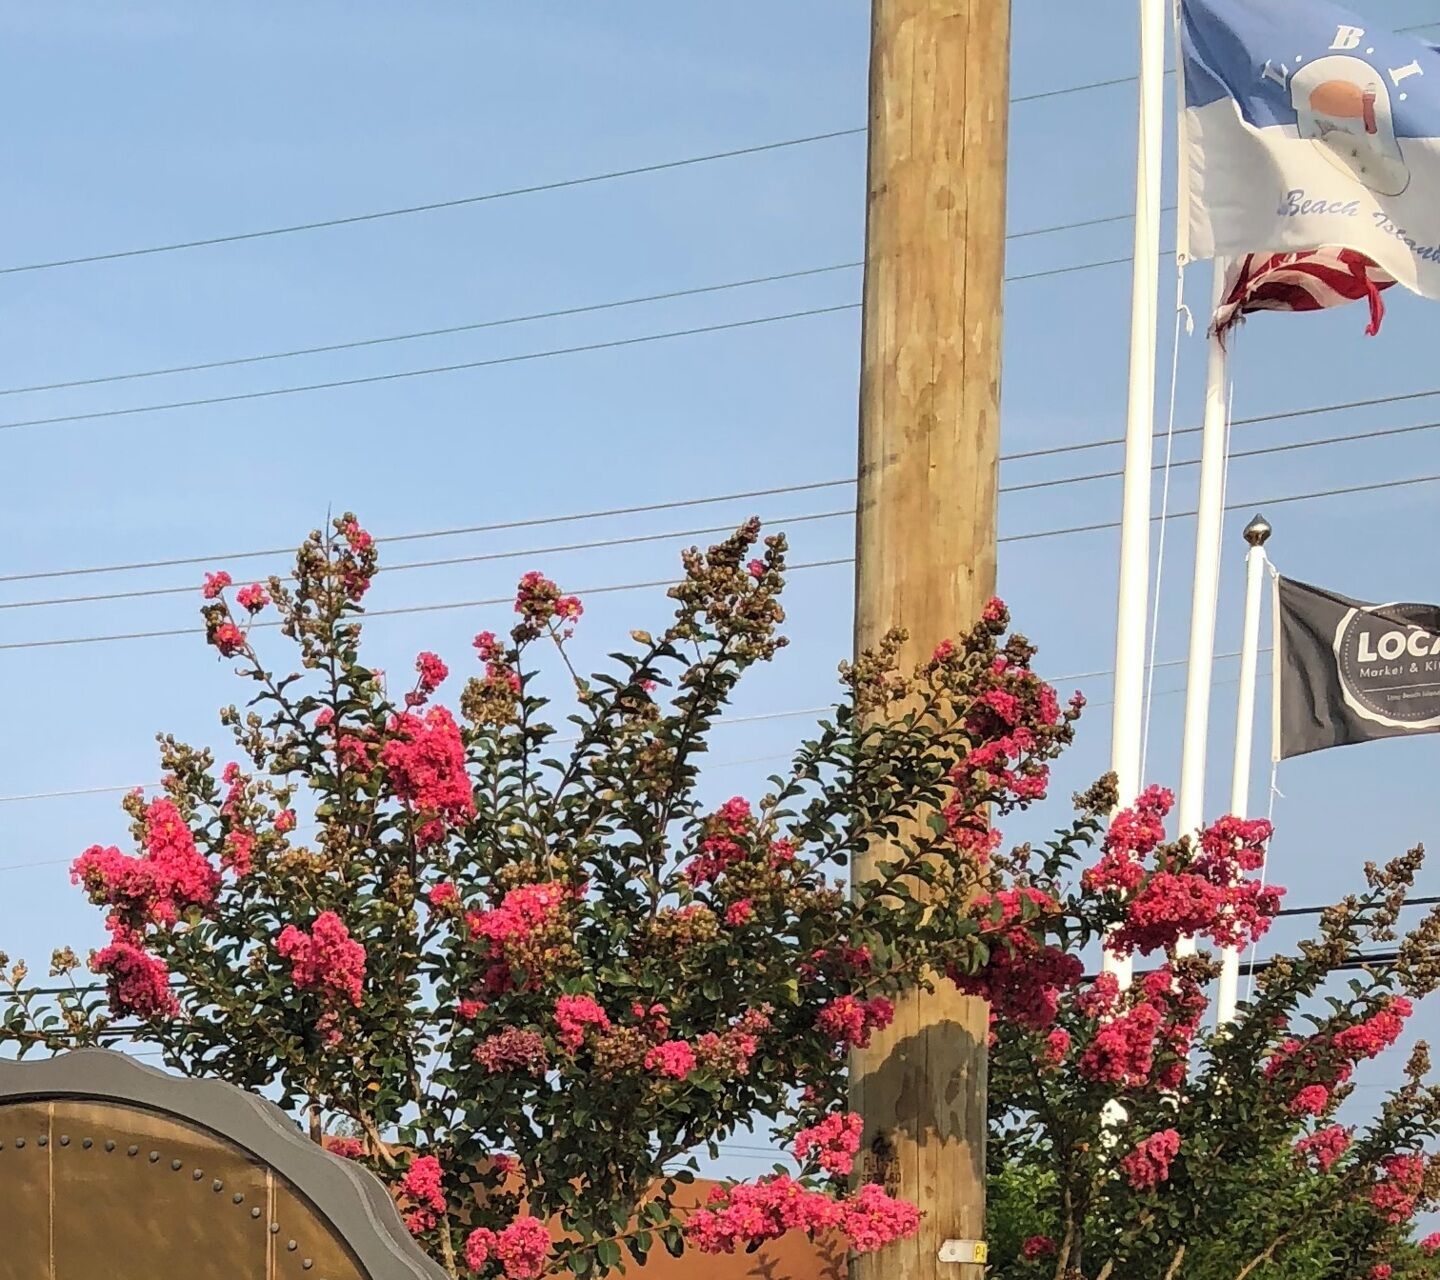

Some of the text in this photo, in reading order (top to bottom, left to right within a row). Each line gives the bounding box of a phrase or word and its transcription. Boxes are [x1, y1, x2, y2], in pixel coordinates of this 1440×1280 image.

[1286, 189, 1360, 217] Beach
[1360, 665, 1403, 678] Market
[1409, 662, 1418, 673] &
